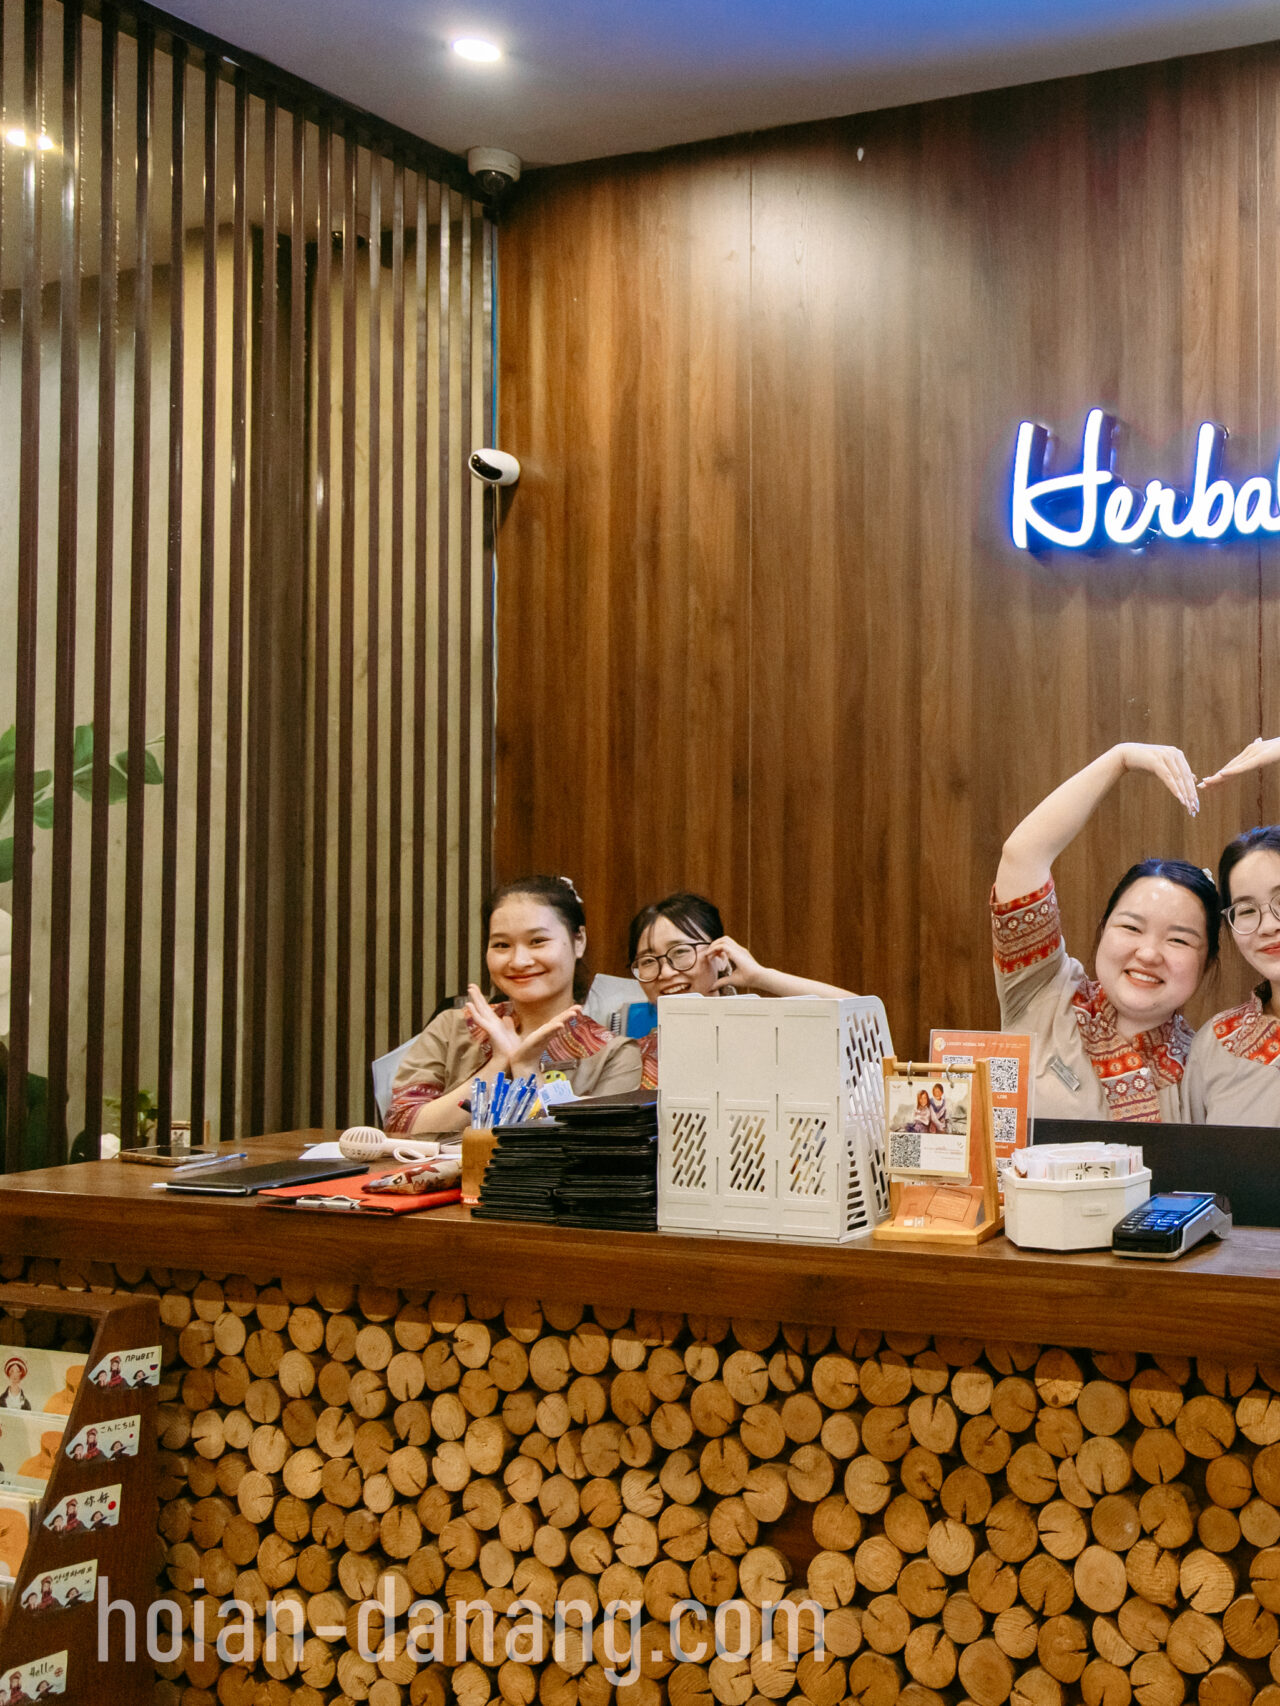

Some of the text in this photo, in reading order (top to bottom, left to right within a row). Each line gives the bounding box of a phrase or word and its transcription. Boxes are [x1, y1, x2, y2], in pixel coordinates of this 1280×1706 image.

[100, 1420, 136, 1433] こんにちは
